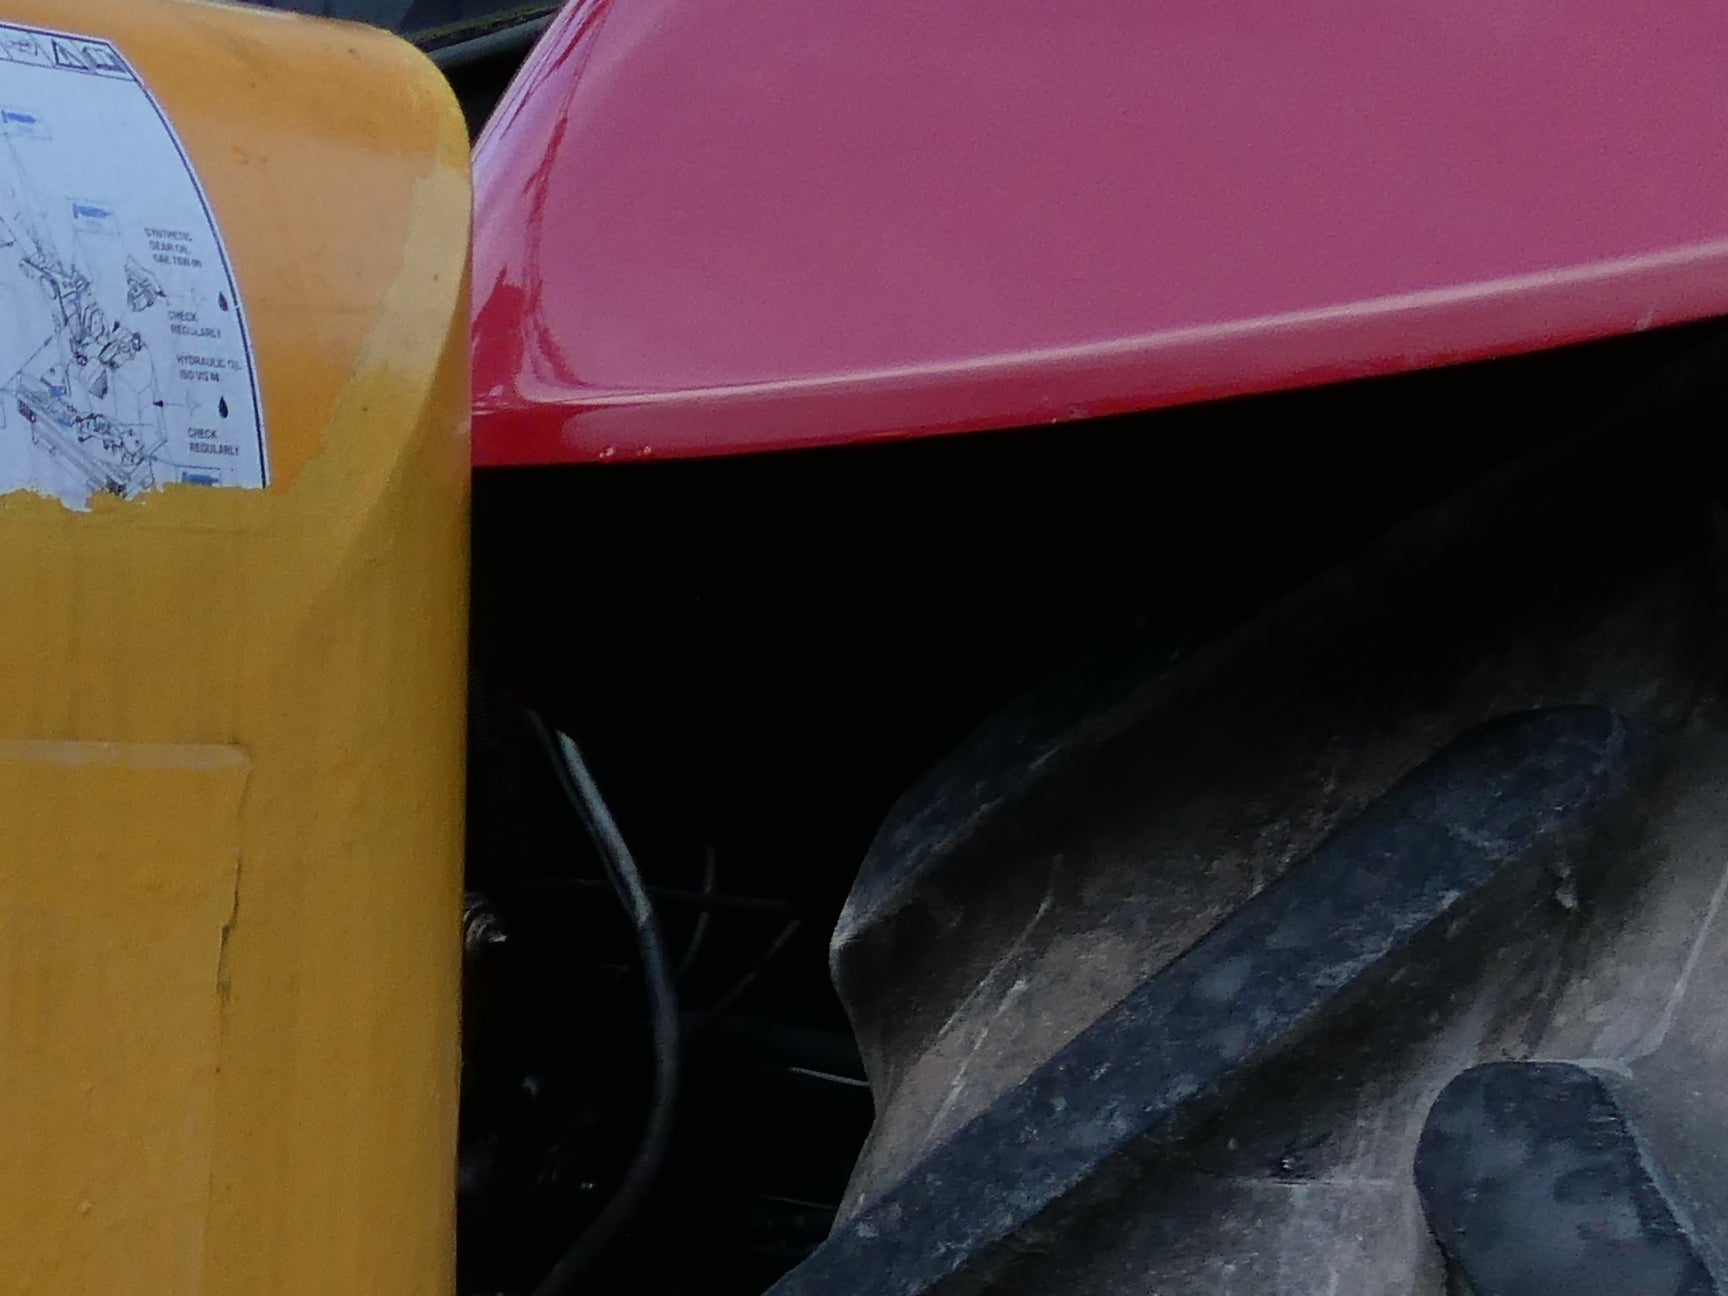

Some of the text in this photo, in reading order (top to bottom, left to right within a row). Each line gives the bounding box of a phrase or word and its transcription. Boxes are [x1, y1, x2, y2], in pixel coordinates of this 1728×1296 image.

[168, 311, 197, 322] CHECK
[170, 324, 222, 339] REGULARLY
[176, 354, 226, 369] HYDRAULIC
[187, 427, 217, 439] CHECK
[189, 443, 239, 456] REGULARLY
